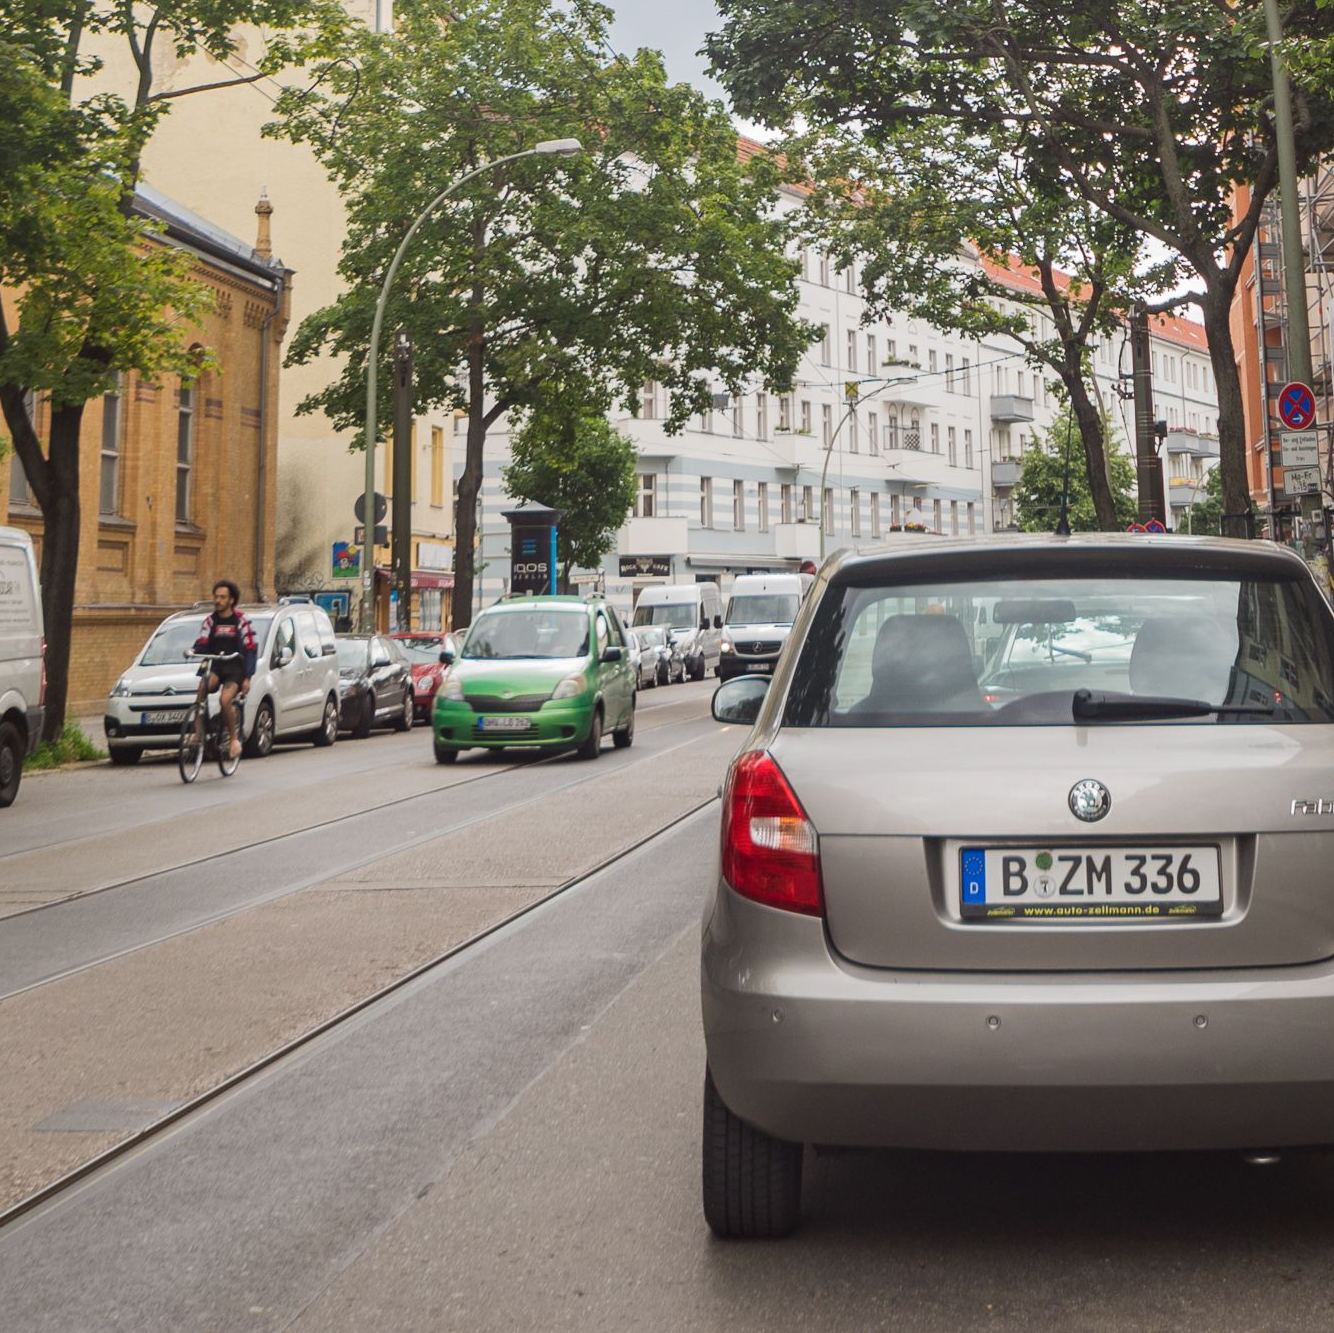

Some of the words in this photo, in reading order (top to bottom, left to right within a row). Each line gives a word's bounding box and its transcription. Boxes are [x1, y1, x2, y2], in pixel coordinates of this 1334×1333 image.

[513, 562, 548, 573] IQOS
[969, 881, 980, 895] D
[1002, 855, 1029, 897] B
[1058, 854, 1113, 896] ZM
[1123, 853, 1201, 895] 336
[1024, 904, 1160, 916] www.auto-zellmann.de
